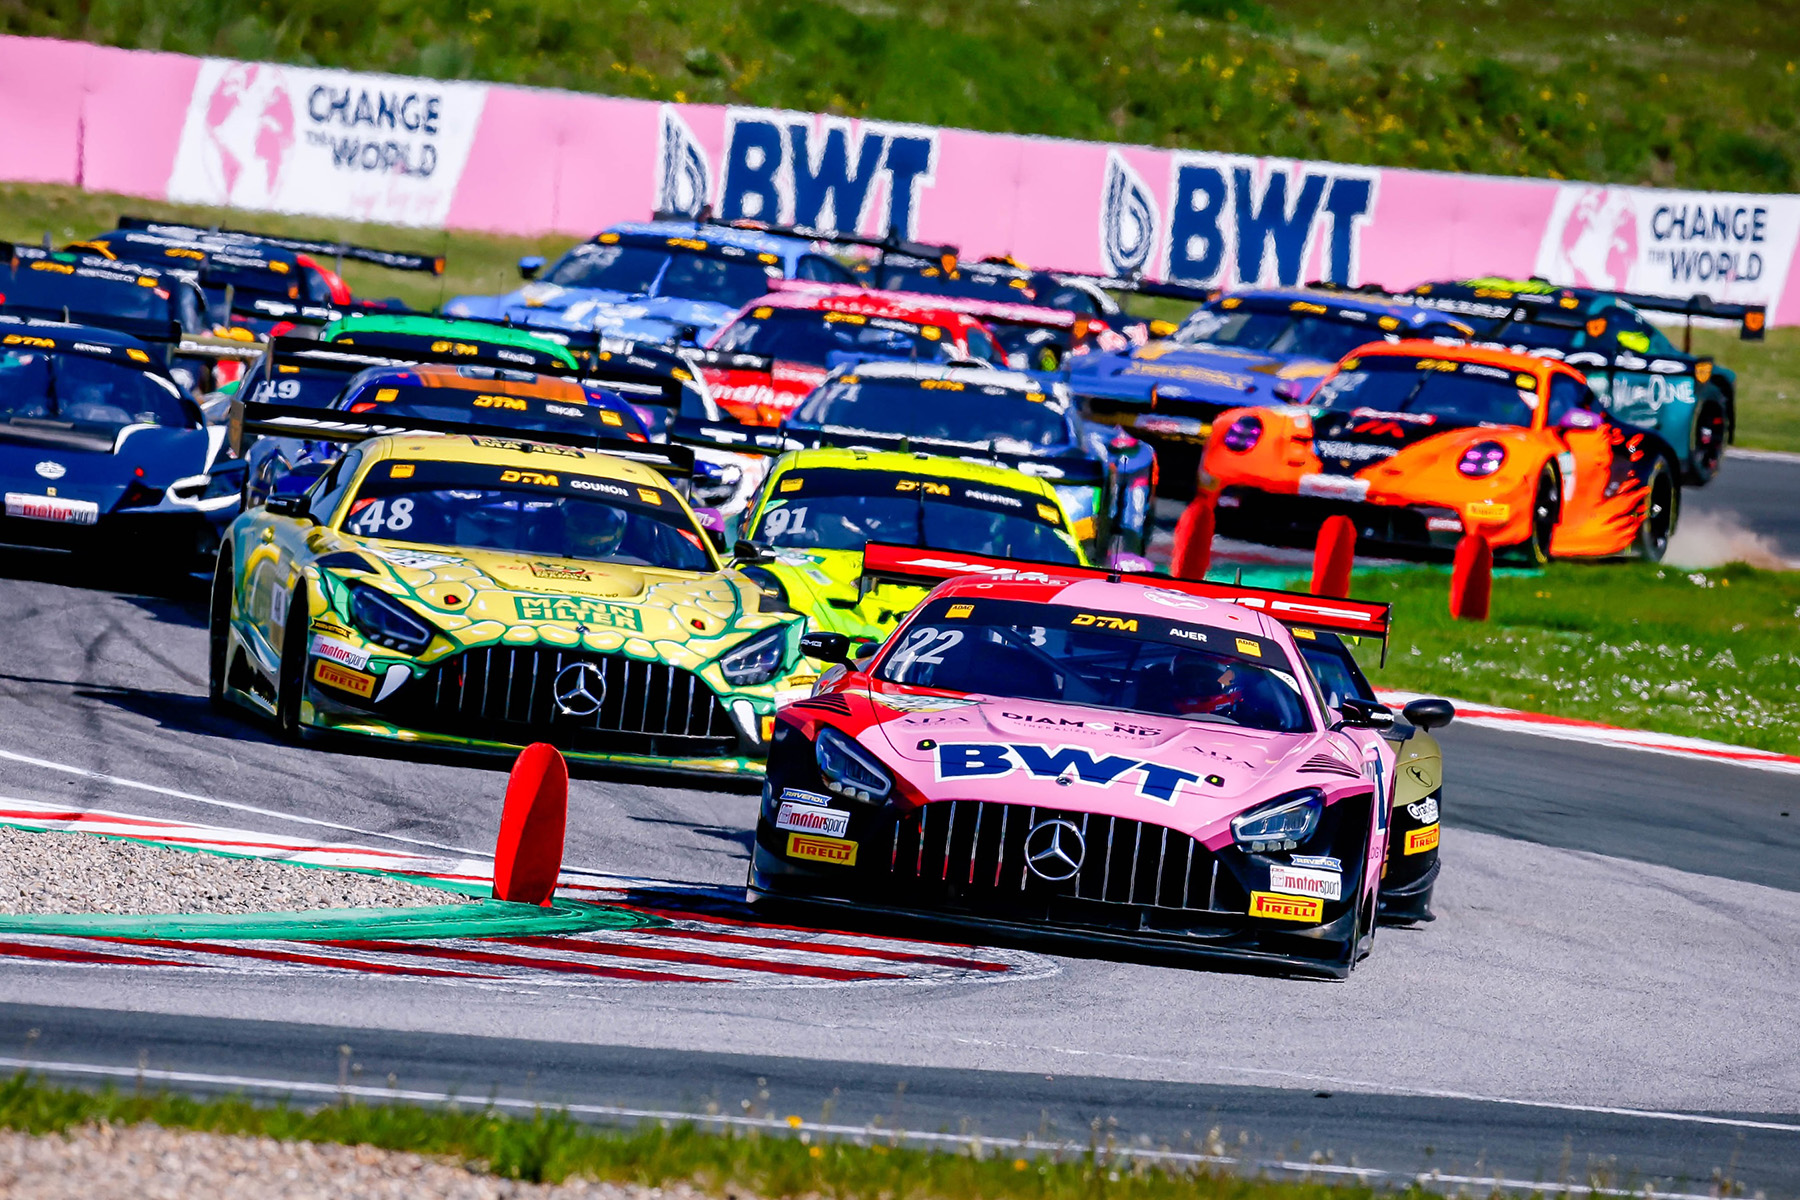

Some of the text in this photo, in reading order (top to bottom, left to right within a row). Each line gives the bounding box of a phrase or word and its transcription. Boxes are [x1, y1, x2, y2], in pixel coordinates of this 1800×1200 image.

[307, 84, 440, 135] CHANGE
[333, 139, 437, 177] WORLD
[720, 112, 936, 238] BWT
[1166, 158, 1376, 287] BWT
[1652, 205, 1767, 241] CHANGE
[1671, 250, 1763, 282] WORLD
[473, 395, 527, 411] DTM
[500, 470, 630, 497] DTM GOUNON
[359, 497, 415, 533] 48
[764, 507, 808, 537] 91
[521, 598, 635, 618] MANN
[523, 607, 637, 630] FILTER
[1071, 613, 1208, 643] DTM AUER
[892, 627, 965, 664] 22
[319, 664, 369, 692] PIRELLI
[936, 742, 1202, 805] BWT
[785, 790, 824, 803] RAVENOL
[789, 811, 847, 834] motorsport
[792, 837, 851, 860] PIRELLI
[1296, 857, 1337, 867] RAVENOL
[1284, 875, 1340, 898] motorsport
[1257, 896, 1317, 917] PIRELLI
